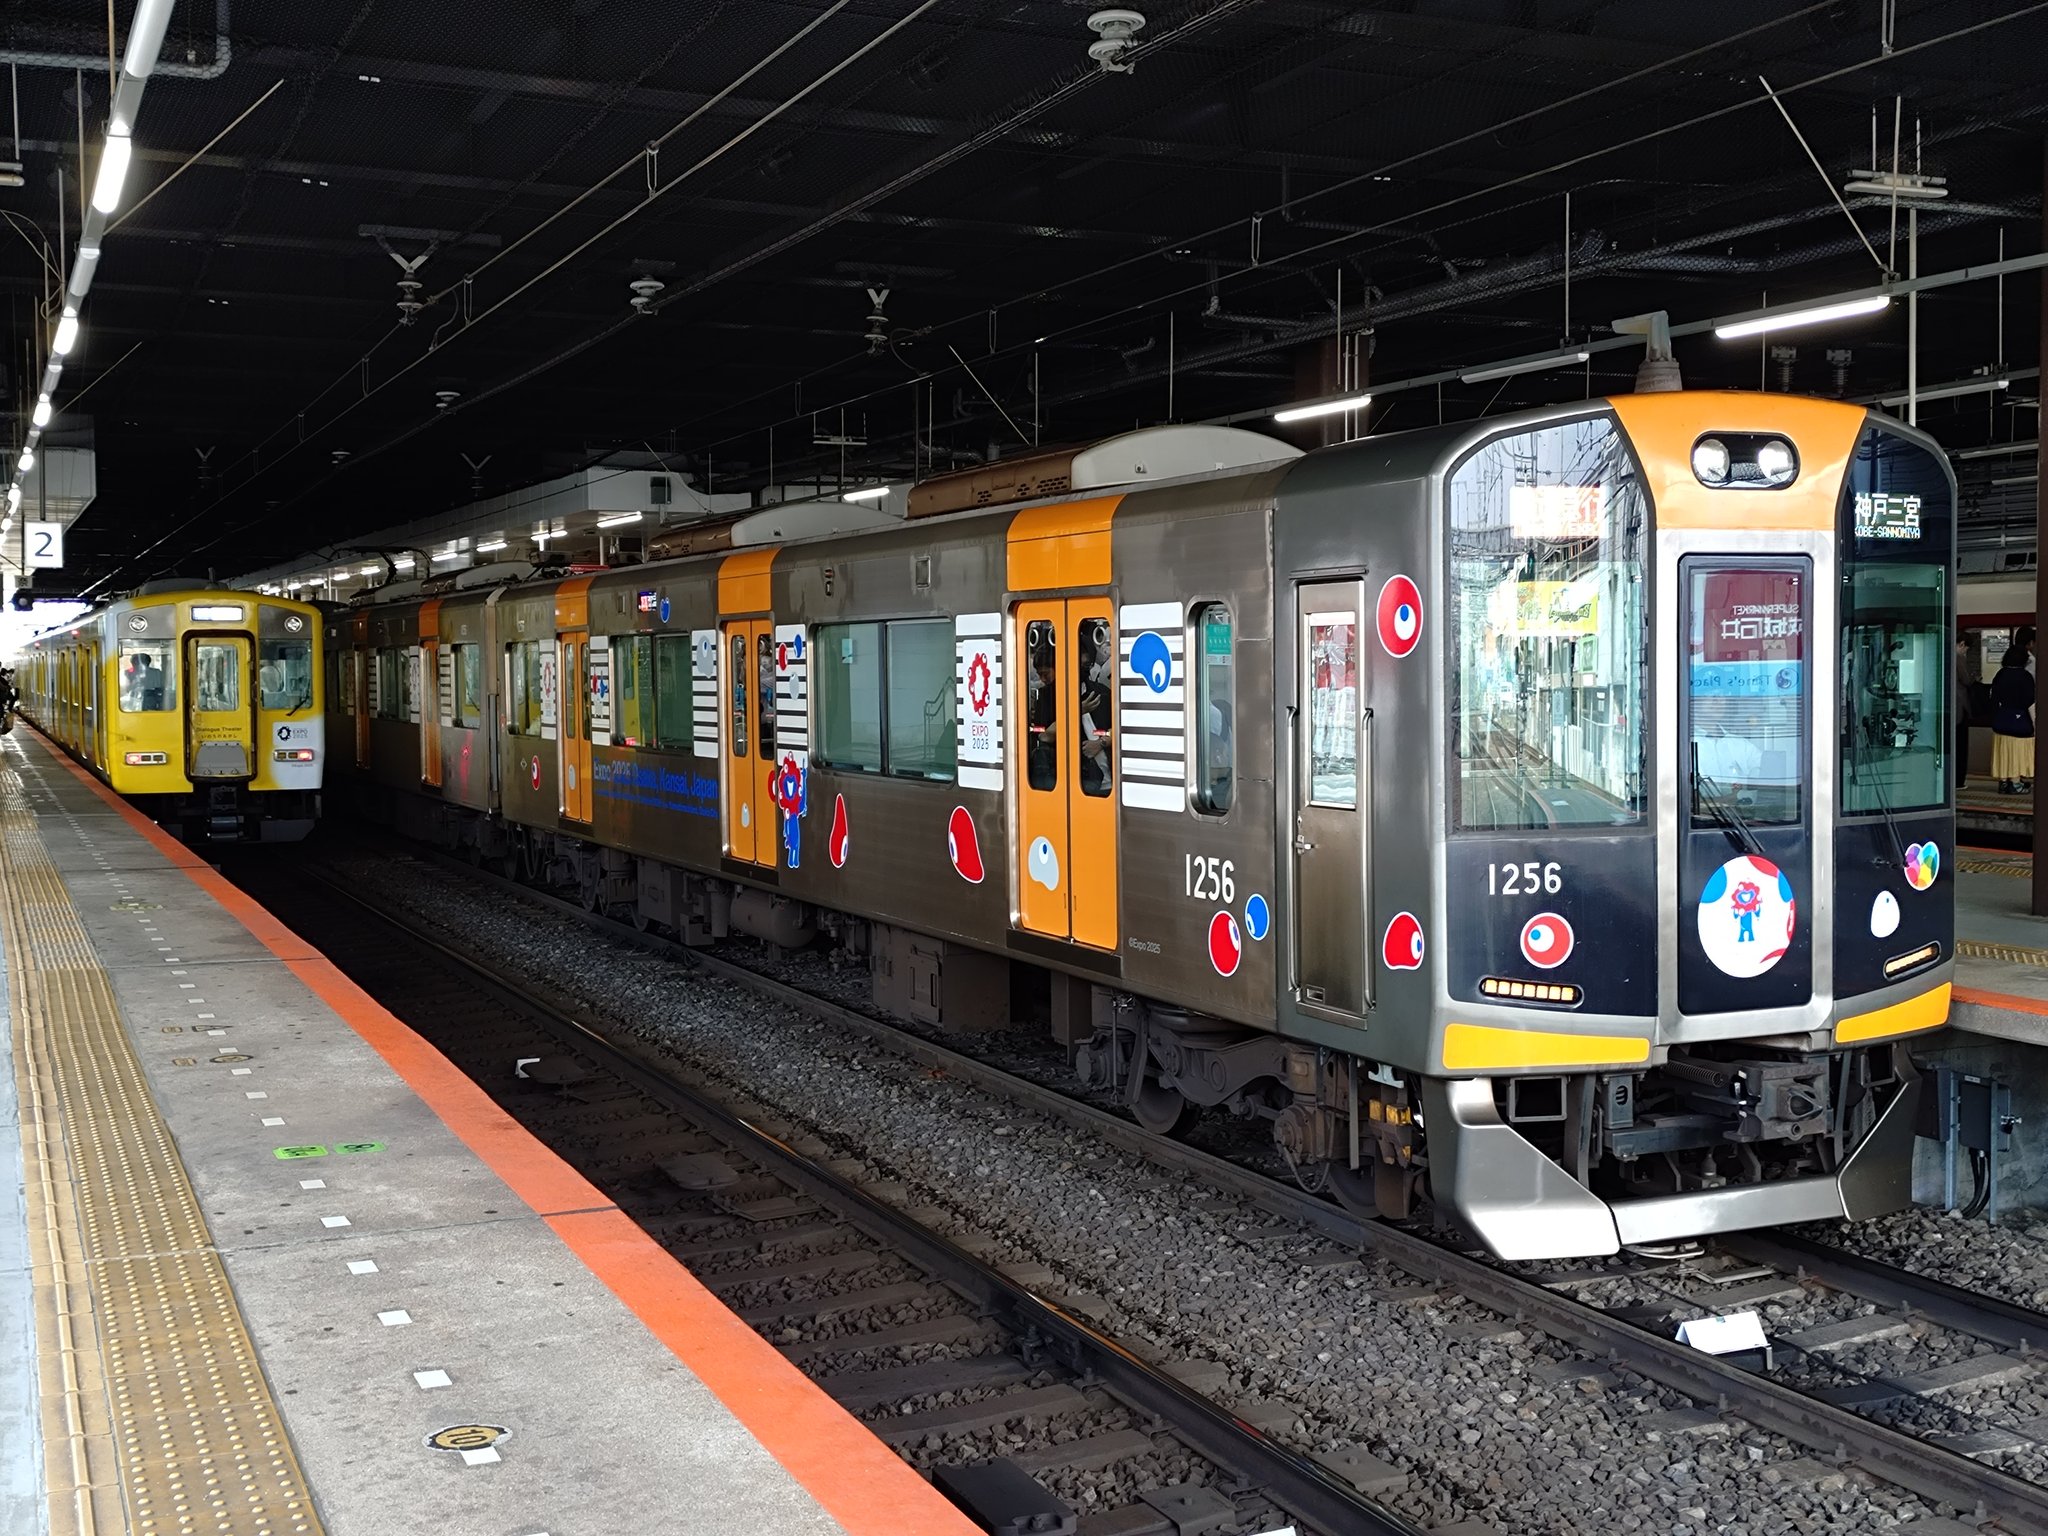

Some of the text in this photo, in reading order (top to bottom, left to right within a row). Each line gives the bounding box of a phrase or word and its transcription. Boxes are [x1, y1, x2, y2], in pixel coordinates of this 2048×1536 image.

[1854, 492, 1921, 527] 神戸三宮
[1854, 526, 1921, 539] KOBE-SANNOMIYA
[35, 532, 53, 557] 2
[971, 725, 989, 737] EXPO
[972, 738, 990, 750] 2025
[691, 771, 718, 803] Japan
[1185, 853, 1235, 904] 1256
[1488, 862, 1562, 895] 1256
[1147, 941, 1161, 954] 2025
[447, 1429, 488, 1445] 10
